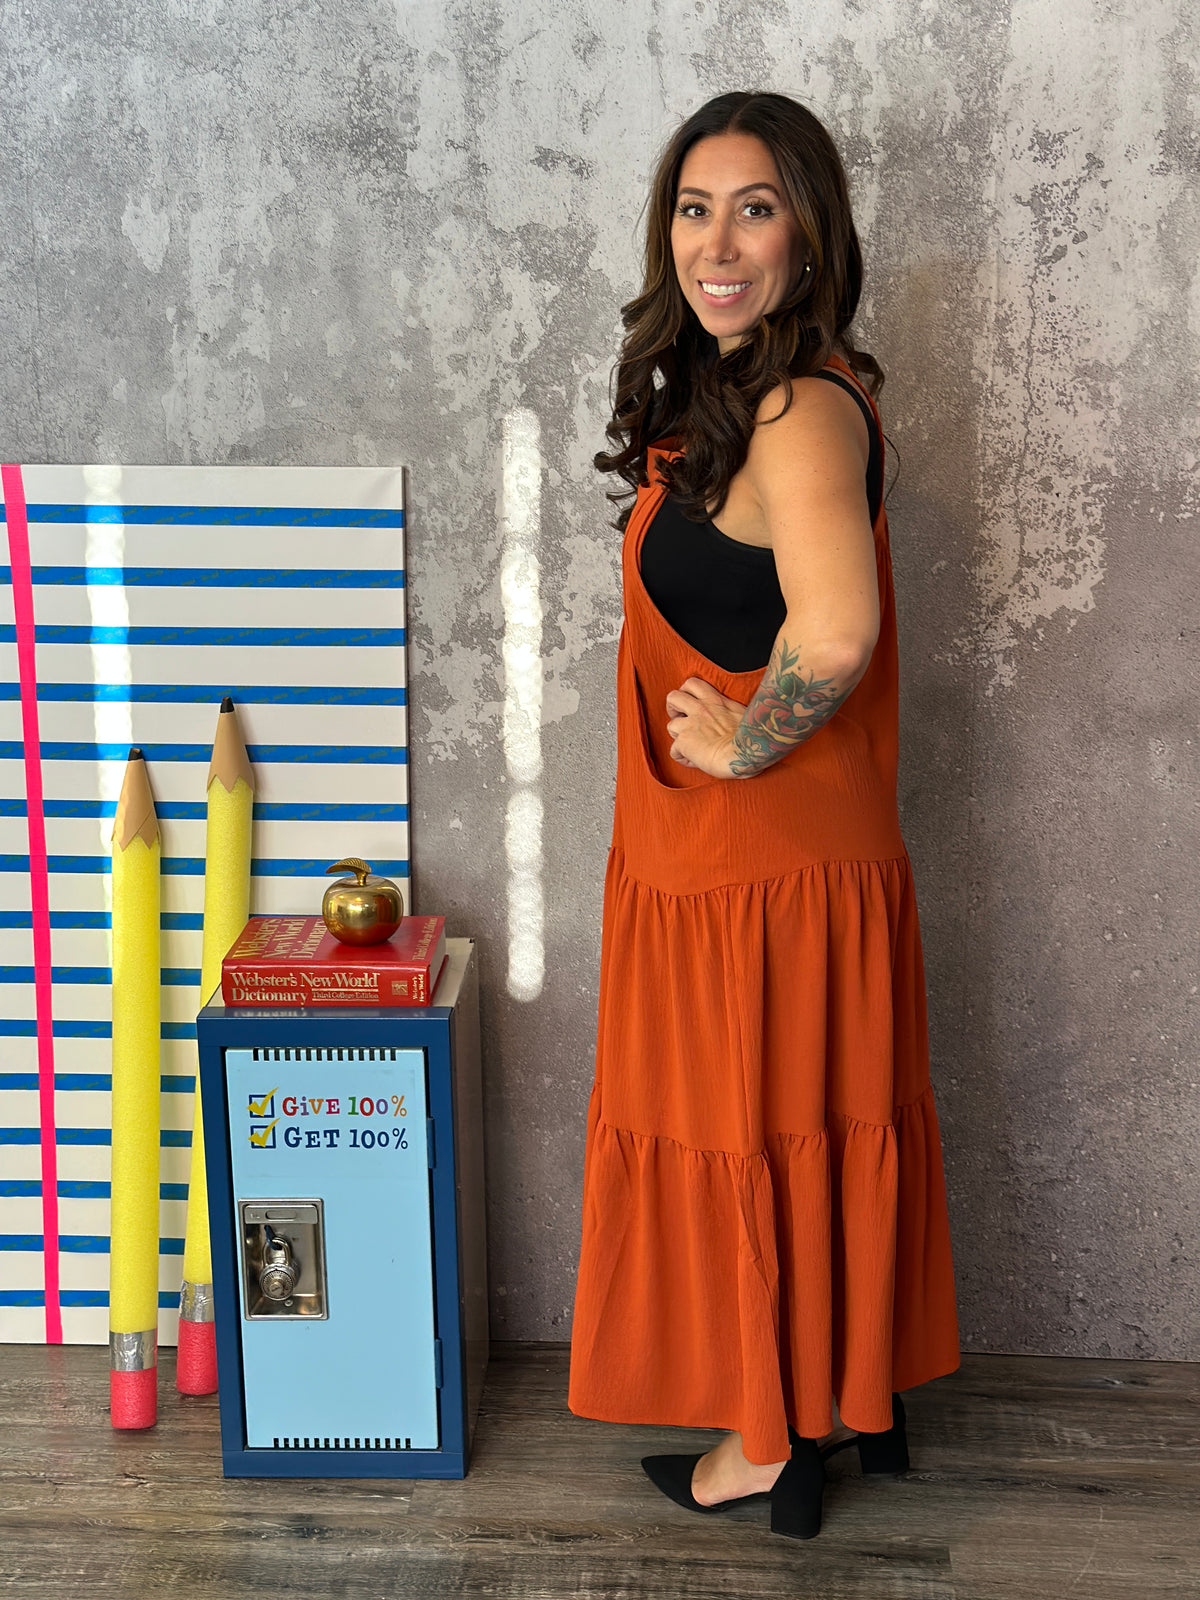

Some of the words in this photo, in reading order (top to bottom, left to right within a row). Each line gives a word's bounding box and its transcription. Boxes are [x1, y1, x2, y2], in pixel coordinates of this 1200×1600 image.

[232, 918, 282, 959] Webster's
[271, 918, 307, 942] World
[261, 941, 294, 959] New
[230, 972, 298, 987] Webster's
[300, 972, 335, 987] New
[333, 972, 380, 988] World
[231, 987, 309, 1005] Dictionary
[313, 991, 331, 999] Third
[331, 991, 355, 1000] College
[347, 1095, 407, 1117] 100%
[283, 1126, 340, 1148] GET
[348, 1127, 409, 1150] 100%
